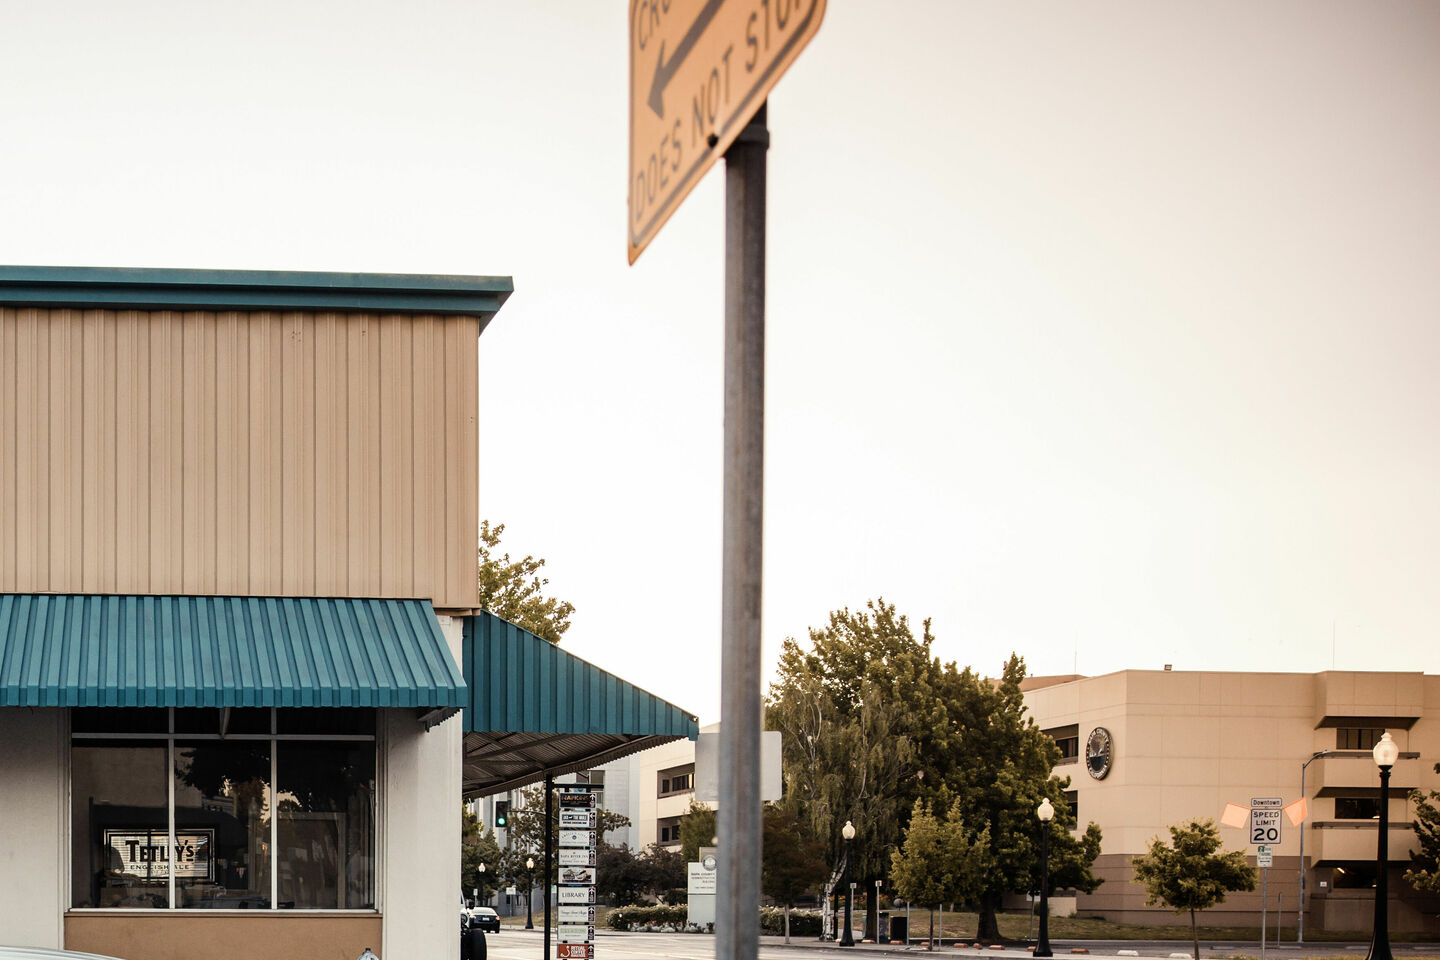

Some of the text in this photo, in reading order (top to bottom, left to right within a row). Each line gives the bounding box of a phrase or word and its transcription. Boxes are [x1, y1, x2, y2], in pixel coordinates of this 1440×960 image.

[638, 0, 670, 51] CR
[635, 0, 801, 222] DOES NOT ST
[125, 839, 195, 863] TETLY'S
[1253, 828, 1278, 841] 20
